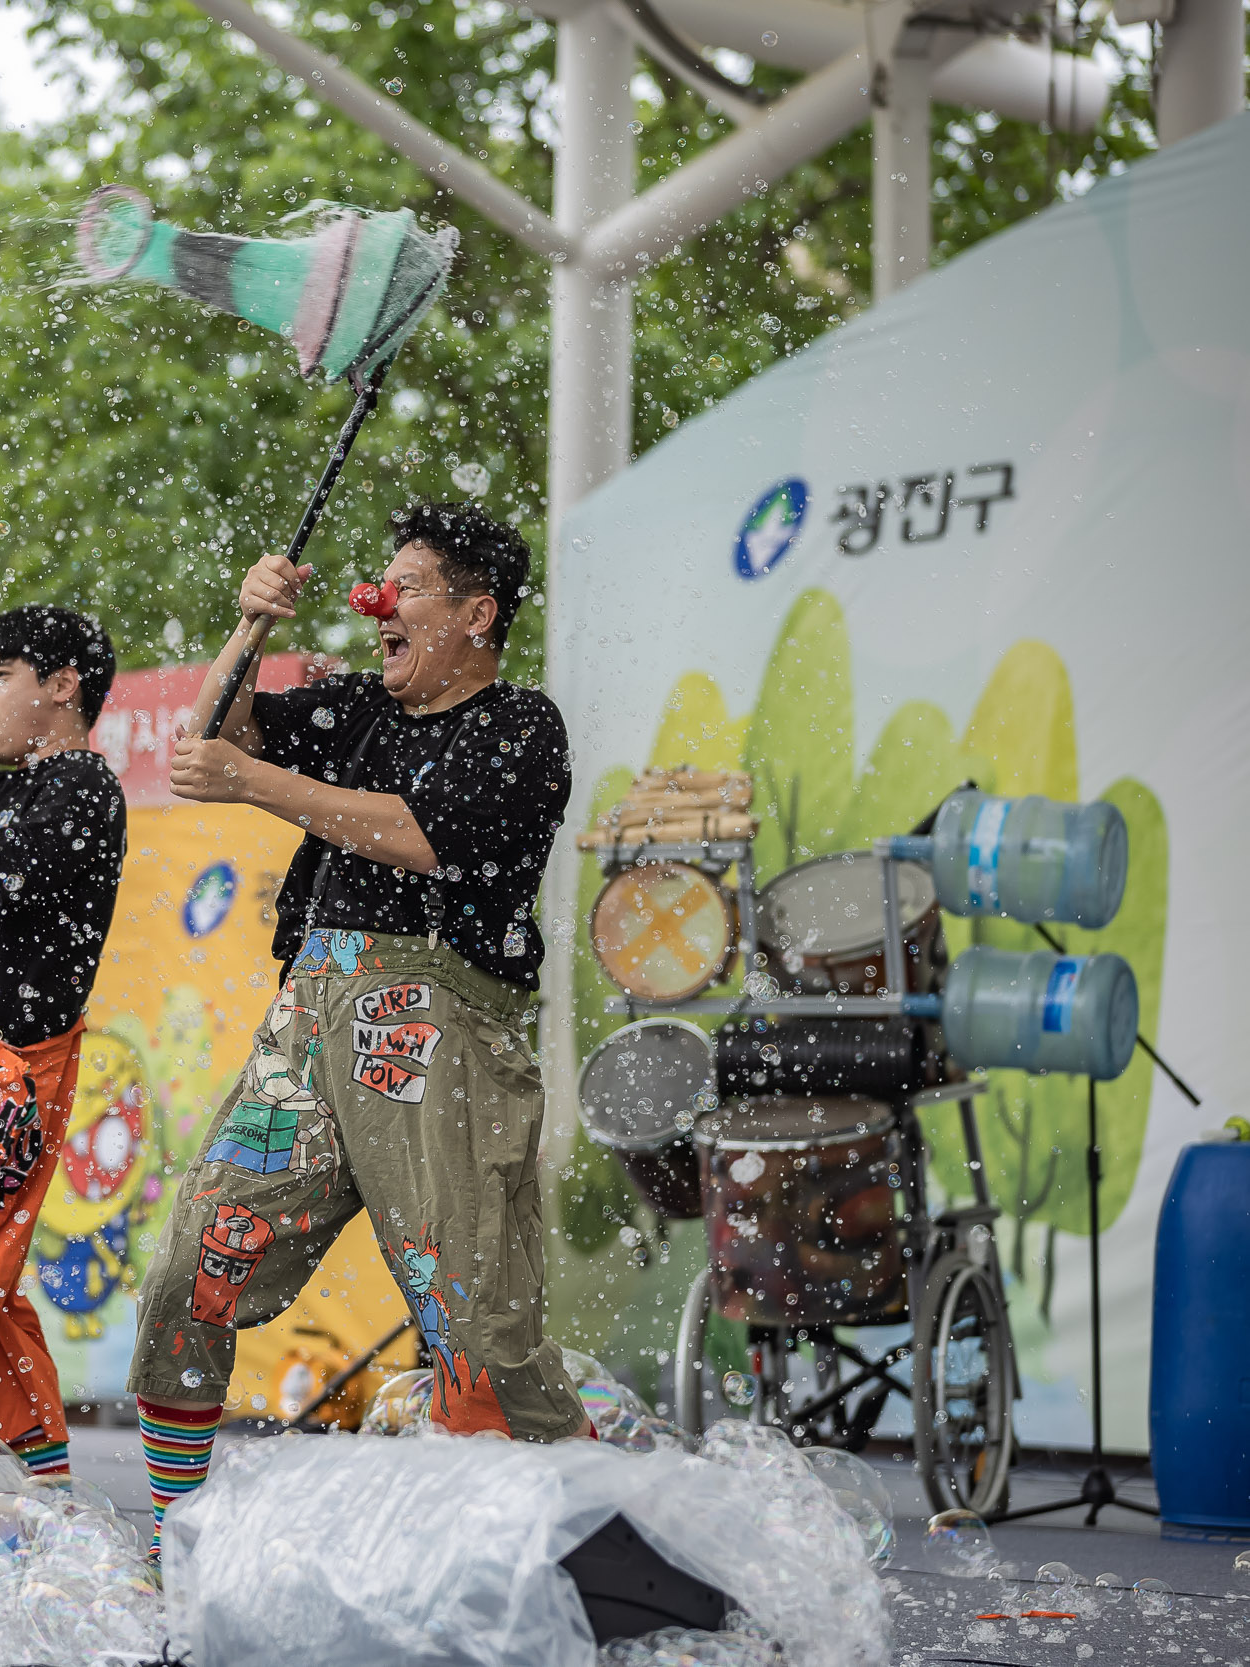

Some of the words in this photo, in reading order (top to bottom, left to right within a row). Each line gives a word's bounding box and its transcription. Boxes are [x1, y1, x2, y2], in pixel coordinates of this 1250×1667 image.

[830, 460, 1016, 556] 광진구
[361, 988, 423, 1020] GIRD
[360, 1057, 413, 1097] POW
